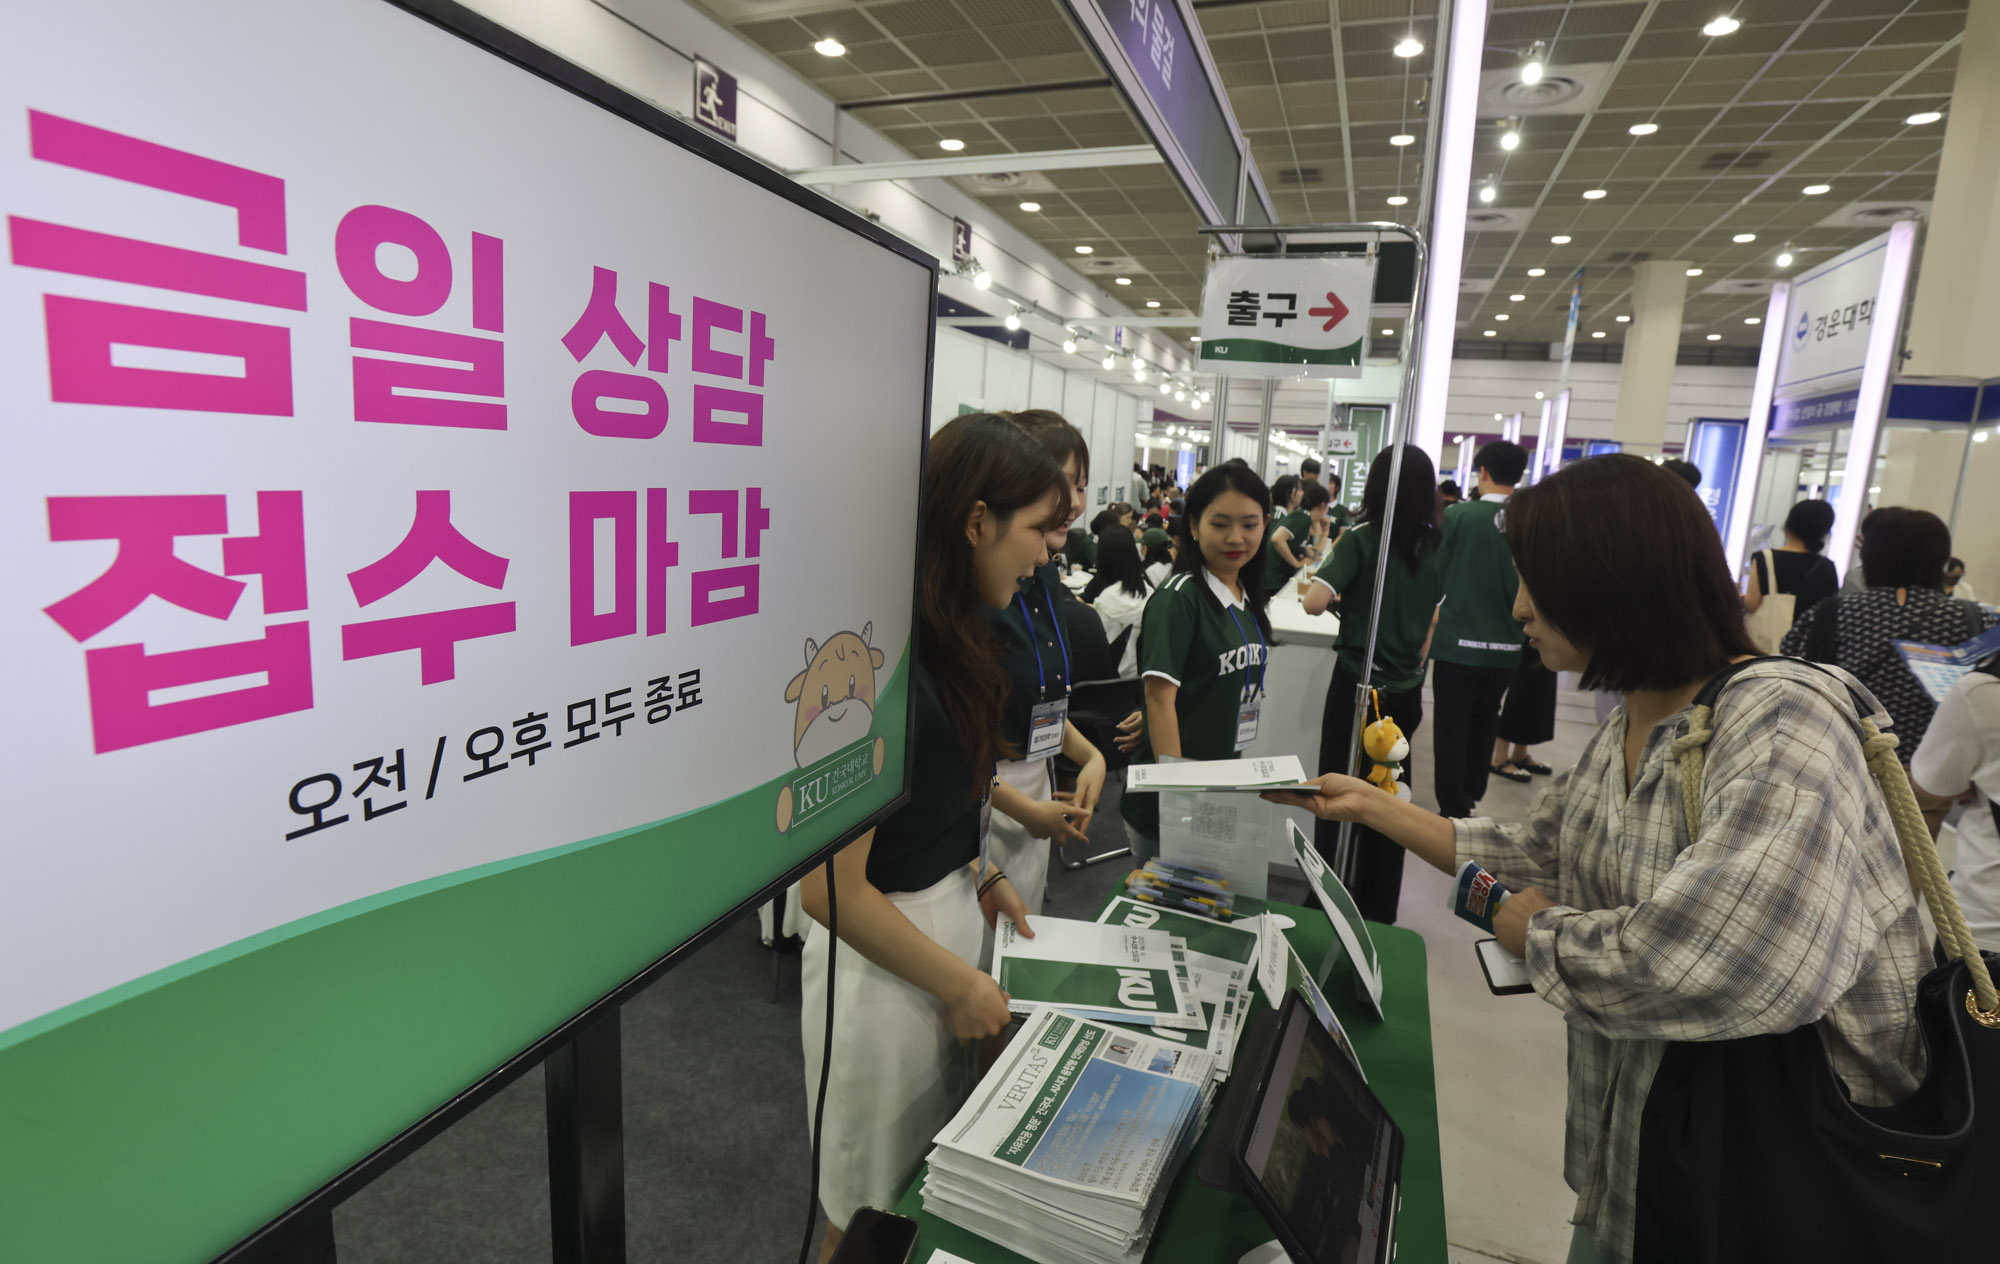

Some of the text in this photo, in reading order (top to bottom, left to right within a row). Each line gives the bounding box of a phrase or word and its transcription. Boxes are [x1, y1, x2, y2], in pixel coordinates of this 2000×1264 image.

[7, 107, 776, 448] 금일 상담
[1227, 290, 1298, 327] 출구
[1214, 345, 1229, 354] KU
[44, 487, 771, 753] 접수 마감
[285, 668, 704, 842] 오전 / 오후 모두 종료
[832, 753, 868, 783] 건국대학교
[799, 772, 831, 815] KU
[1116, 968, 1158, 1010] KU
[1045, 1033, 1058, 1046] KU
[998, 1054, 1049, 1111] VERITAS
